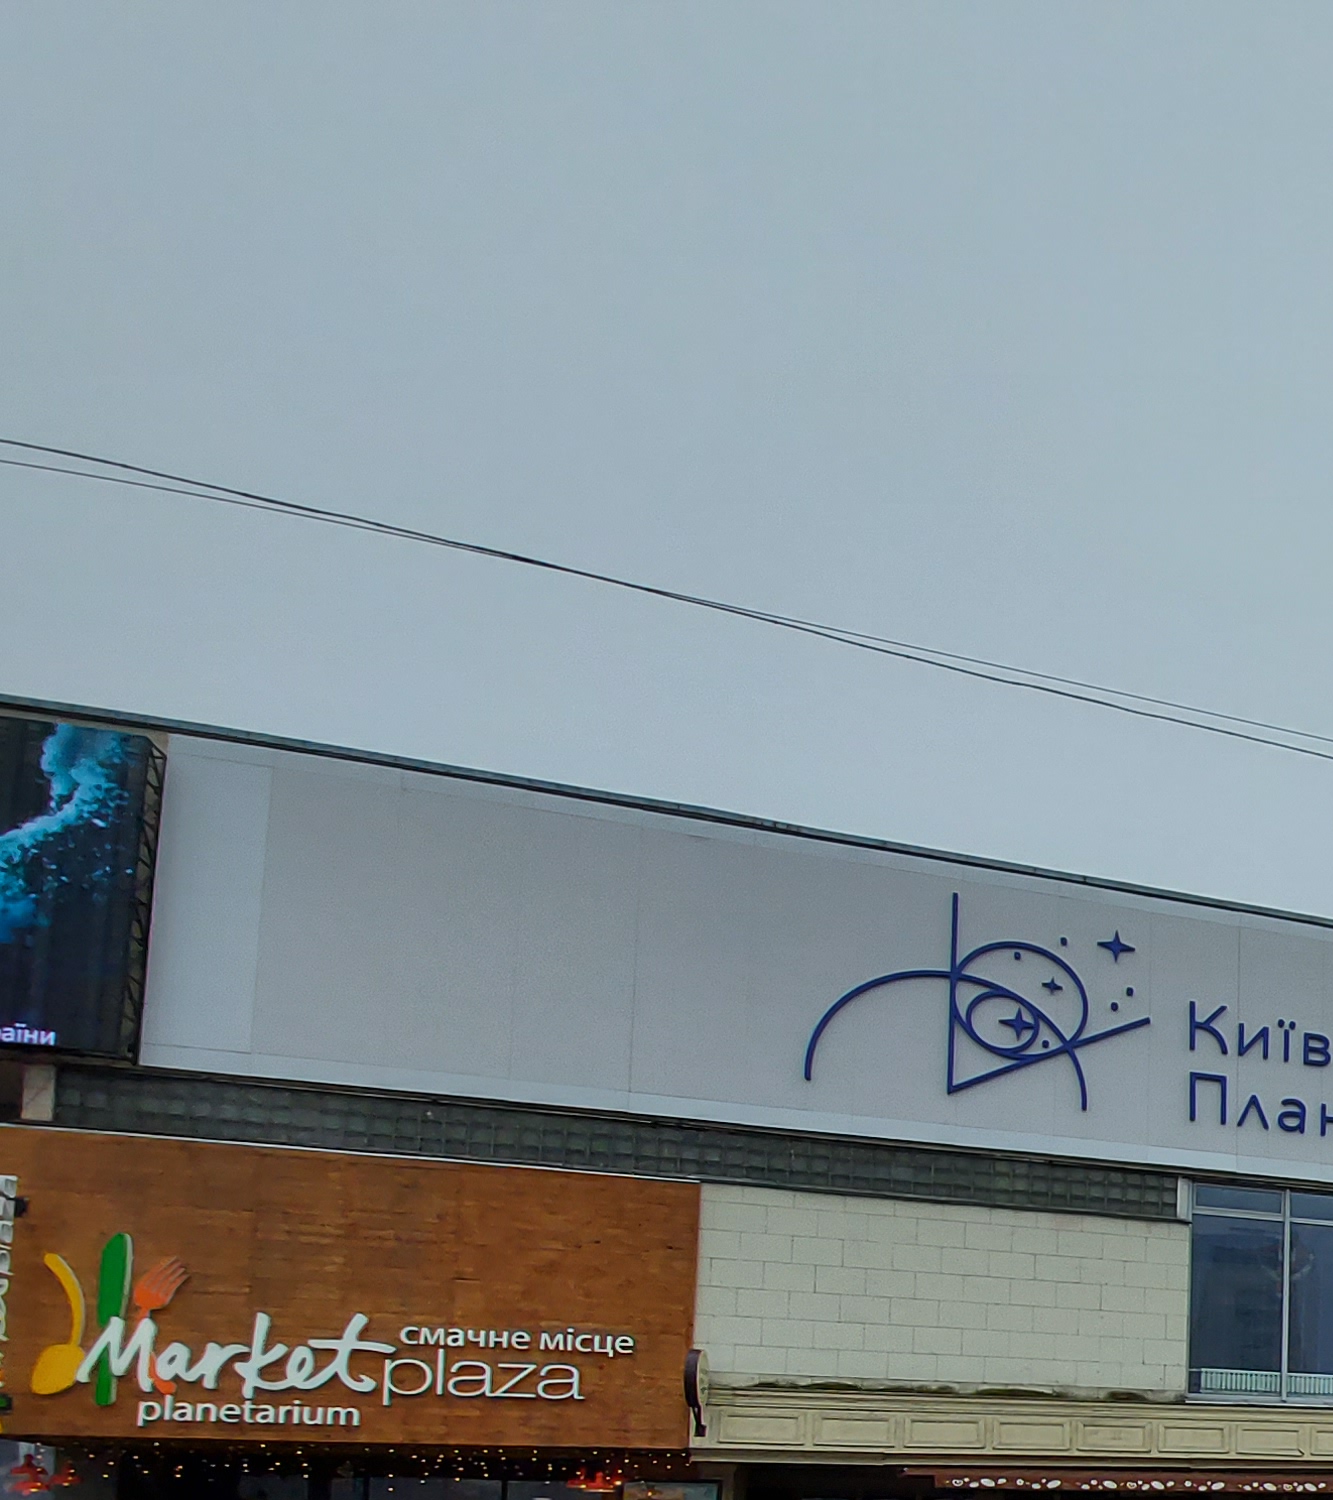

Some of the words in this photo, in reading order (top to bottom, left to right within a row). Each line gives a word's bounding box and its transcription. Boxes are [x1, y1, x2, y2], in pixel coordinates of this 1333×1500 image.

[0, 1022, 57, 1047] аїни
[399, 1325, 529, 1351] смачне
[539, 1329, 635, 1358] місце
[76, 1312, 397, 1398] Market
[382, 1348, 585, 1405] plaza
[137, 1396, 361, 1427] planetarium
